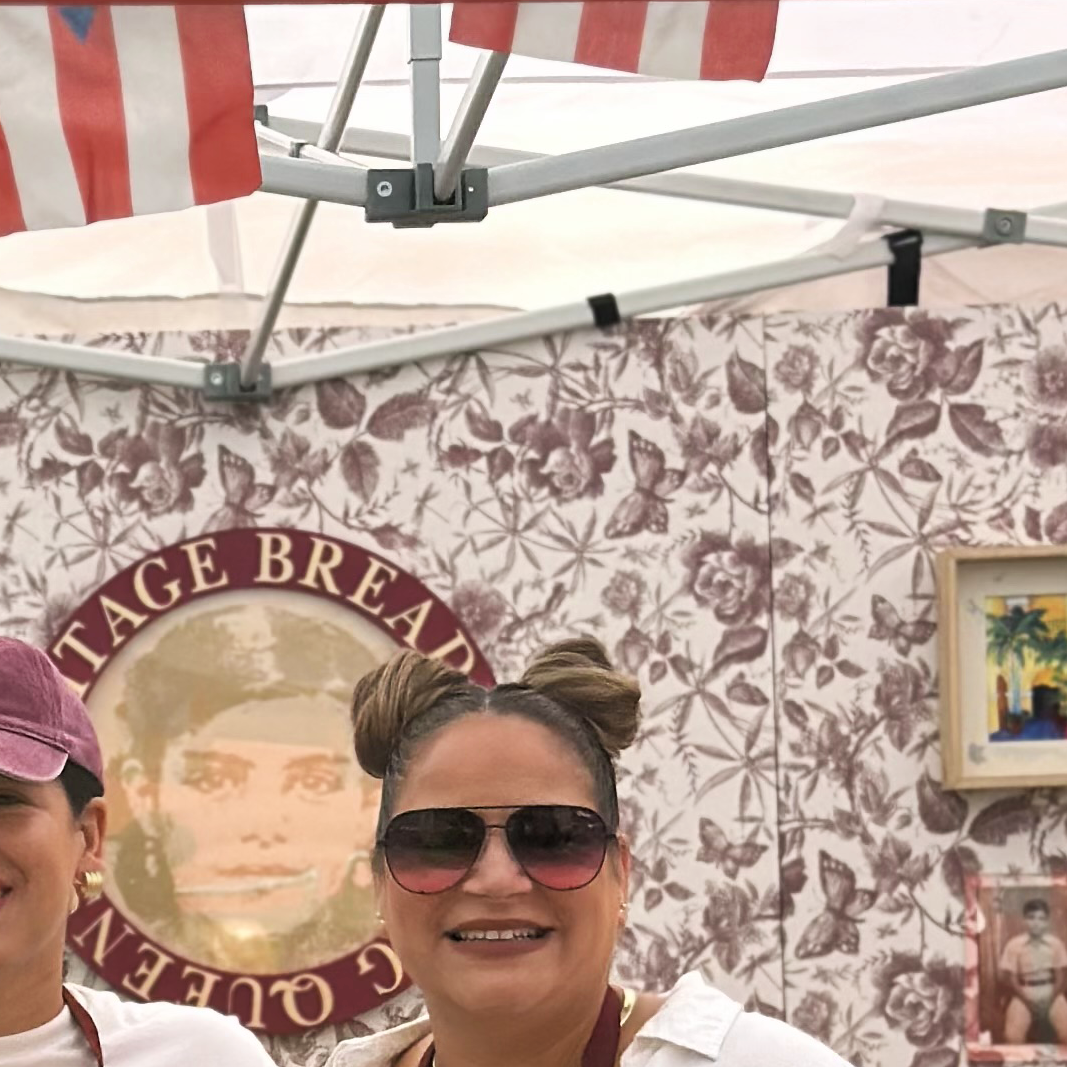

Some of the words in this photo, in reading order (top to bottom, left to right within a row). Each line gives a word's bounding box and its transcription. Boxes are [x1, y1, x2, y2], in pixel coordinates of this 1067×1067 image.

[53, 537, 229, 698] TAGE
[254, 532, 475, 675] BREAD
[72, 906, 334, 1029] QUEEN
